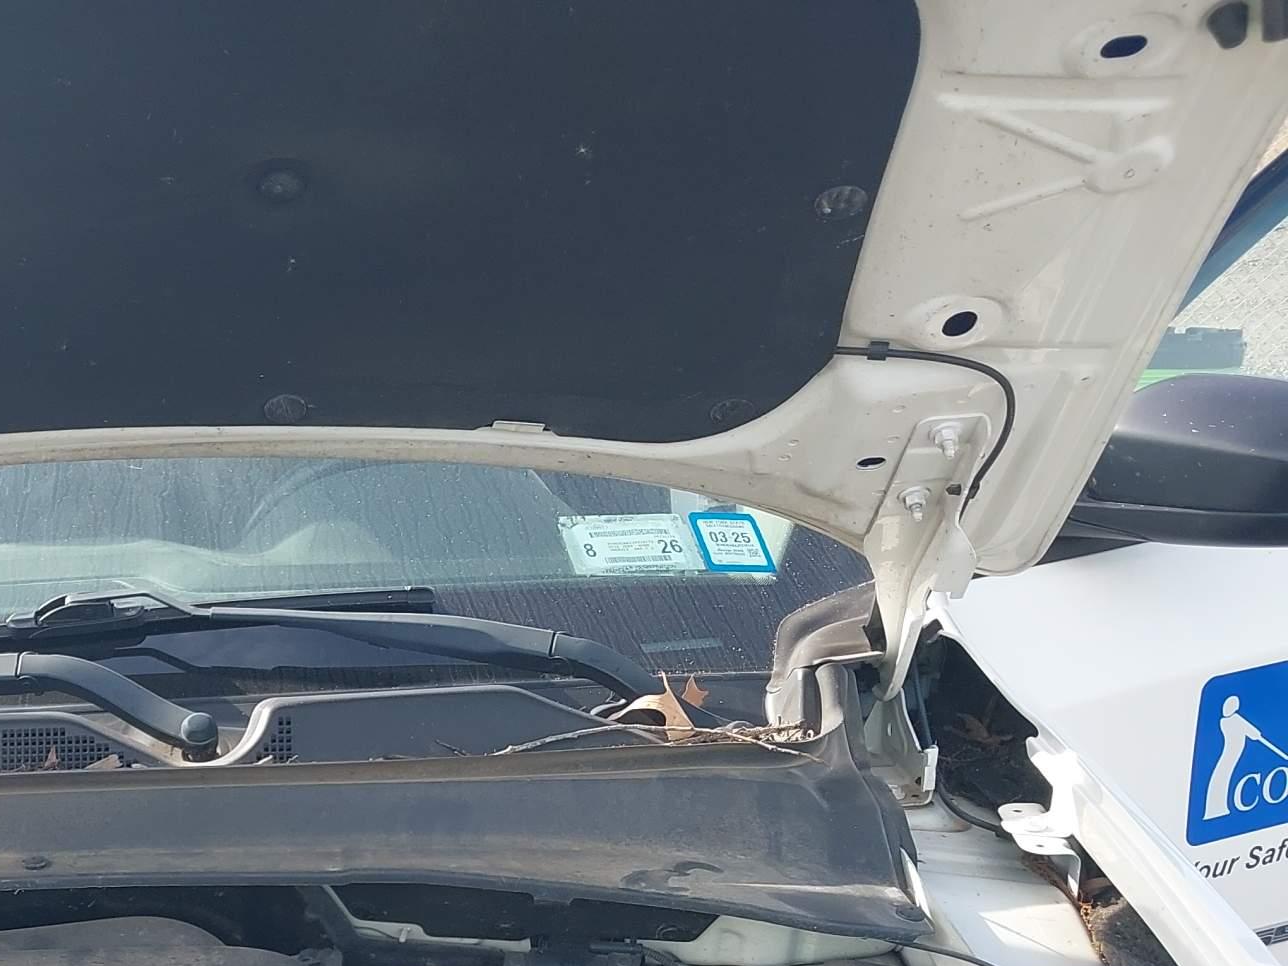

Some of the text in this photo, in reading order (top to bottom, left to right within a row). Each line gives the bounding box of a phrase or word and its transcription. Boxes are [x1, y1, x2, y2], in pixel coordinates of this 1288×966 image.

[709, 531, 751, 543] 03 25
[583, 543, 597, 557] 8
[657, 539, 683, 554] 26
[1194, 838, 1288, 879] our Saf
